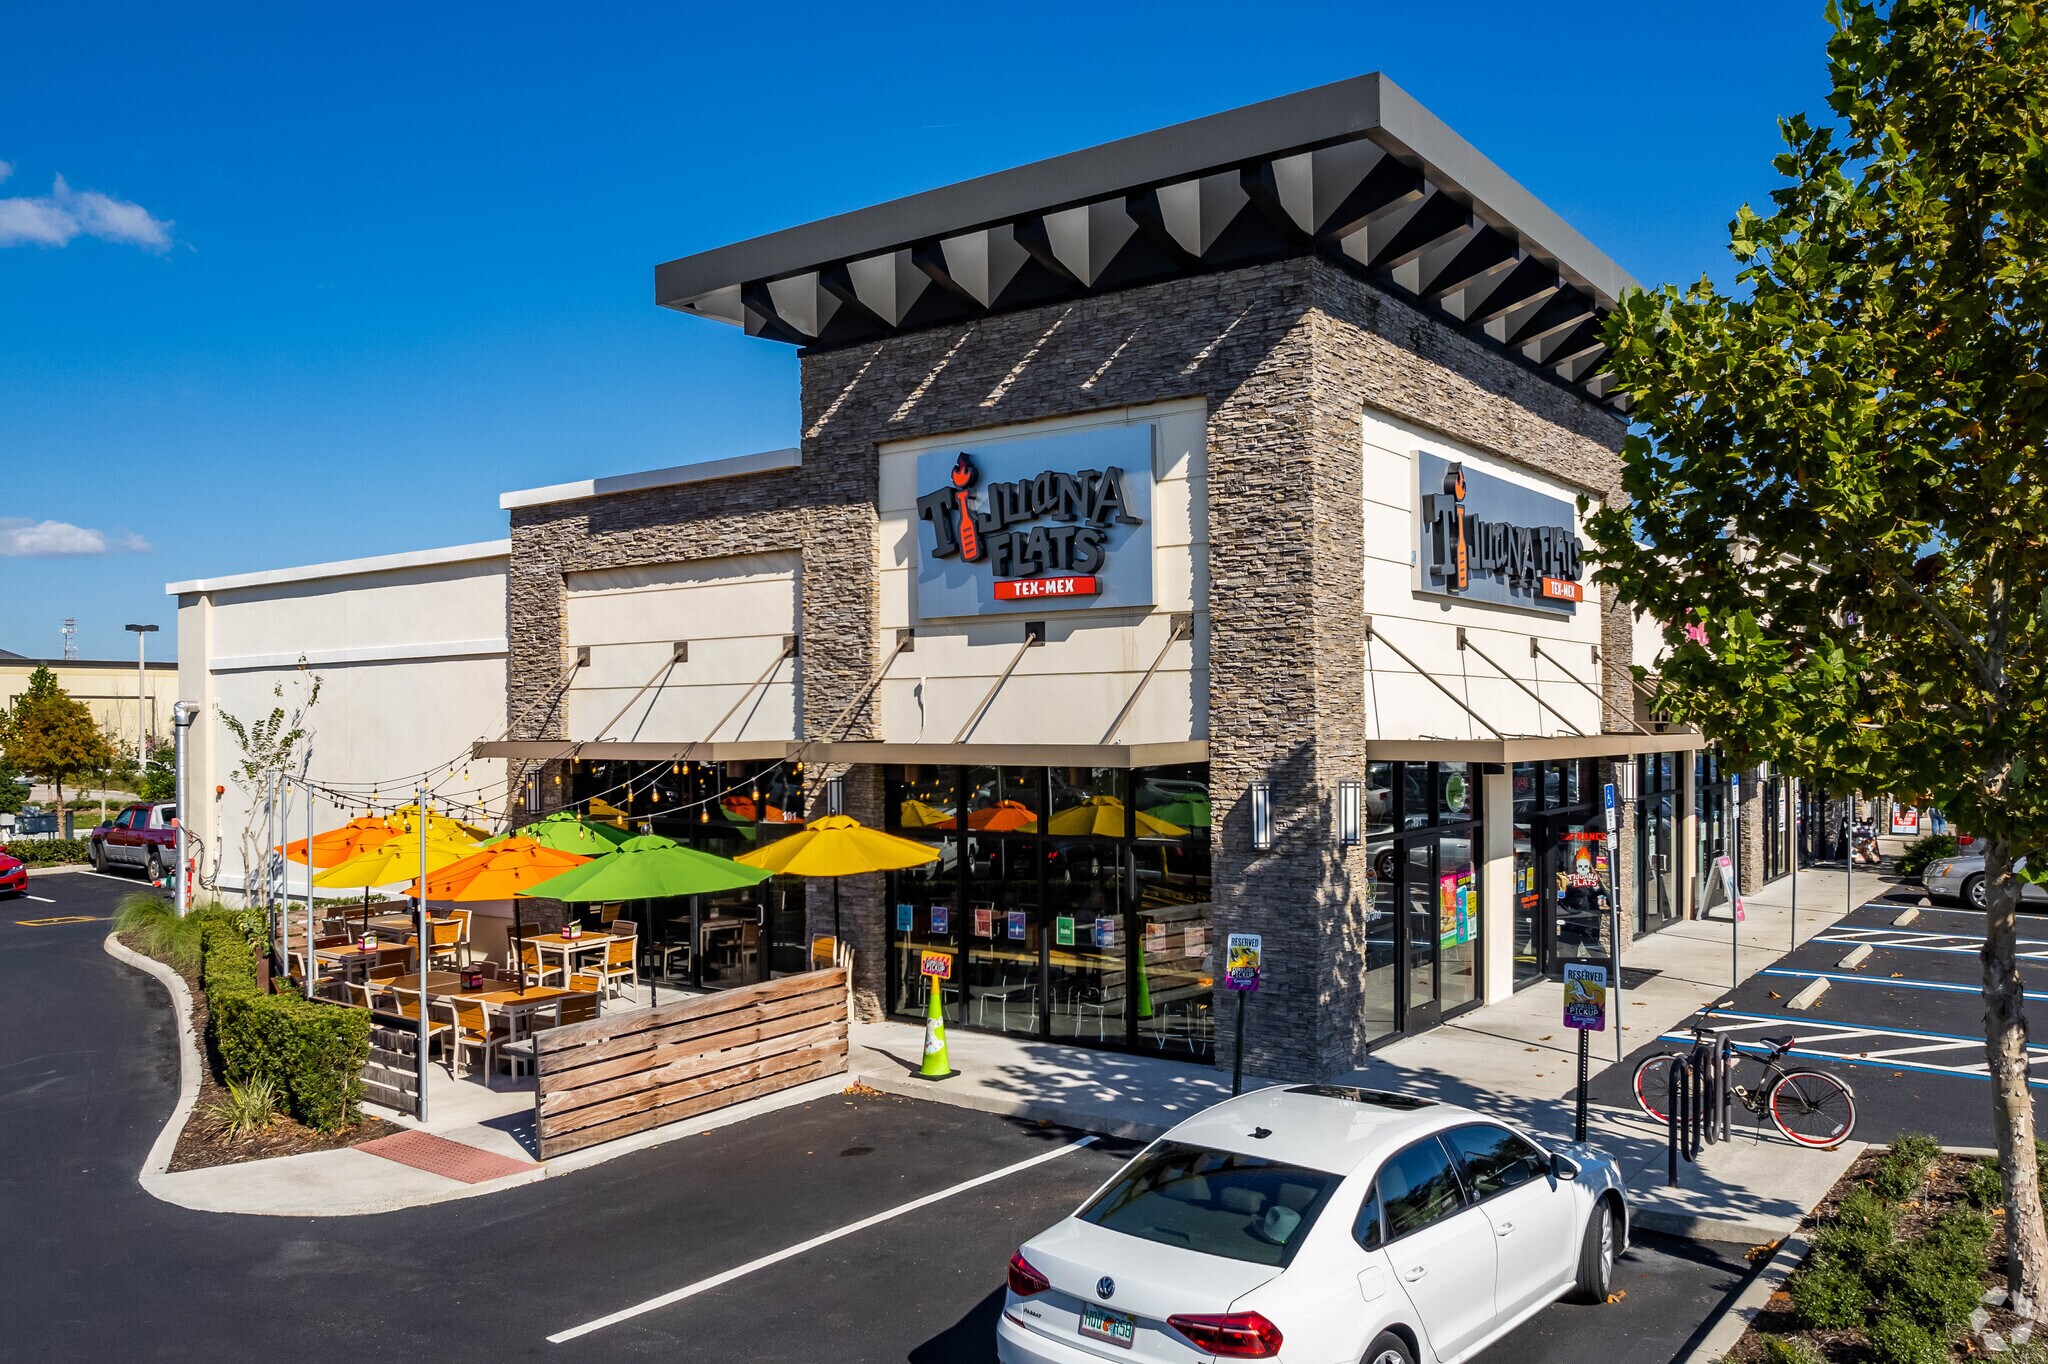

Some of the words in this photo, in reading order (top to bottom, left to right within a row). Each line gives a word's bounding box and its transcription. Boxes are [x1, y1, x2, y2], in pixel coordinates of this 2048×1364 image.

[987, 525, 1107, 577] FLATS
[1538, 526, 1584, 581] FLATS
[1013, 579, 1075, 596] TEX-MEX
[1550, 581, 1576, 599] TEX-MEX
[782, 811, 797, 821] 101
[1573, 879, 1597, 888] FLATS
[1231, 937, 1259, 948] RESERVED
[1230, 970, 1255, 979] PICKUP
[1568, 969, 1603, 983] RESERVED
[1569, 1006, 1599, 1017] PICKUP
